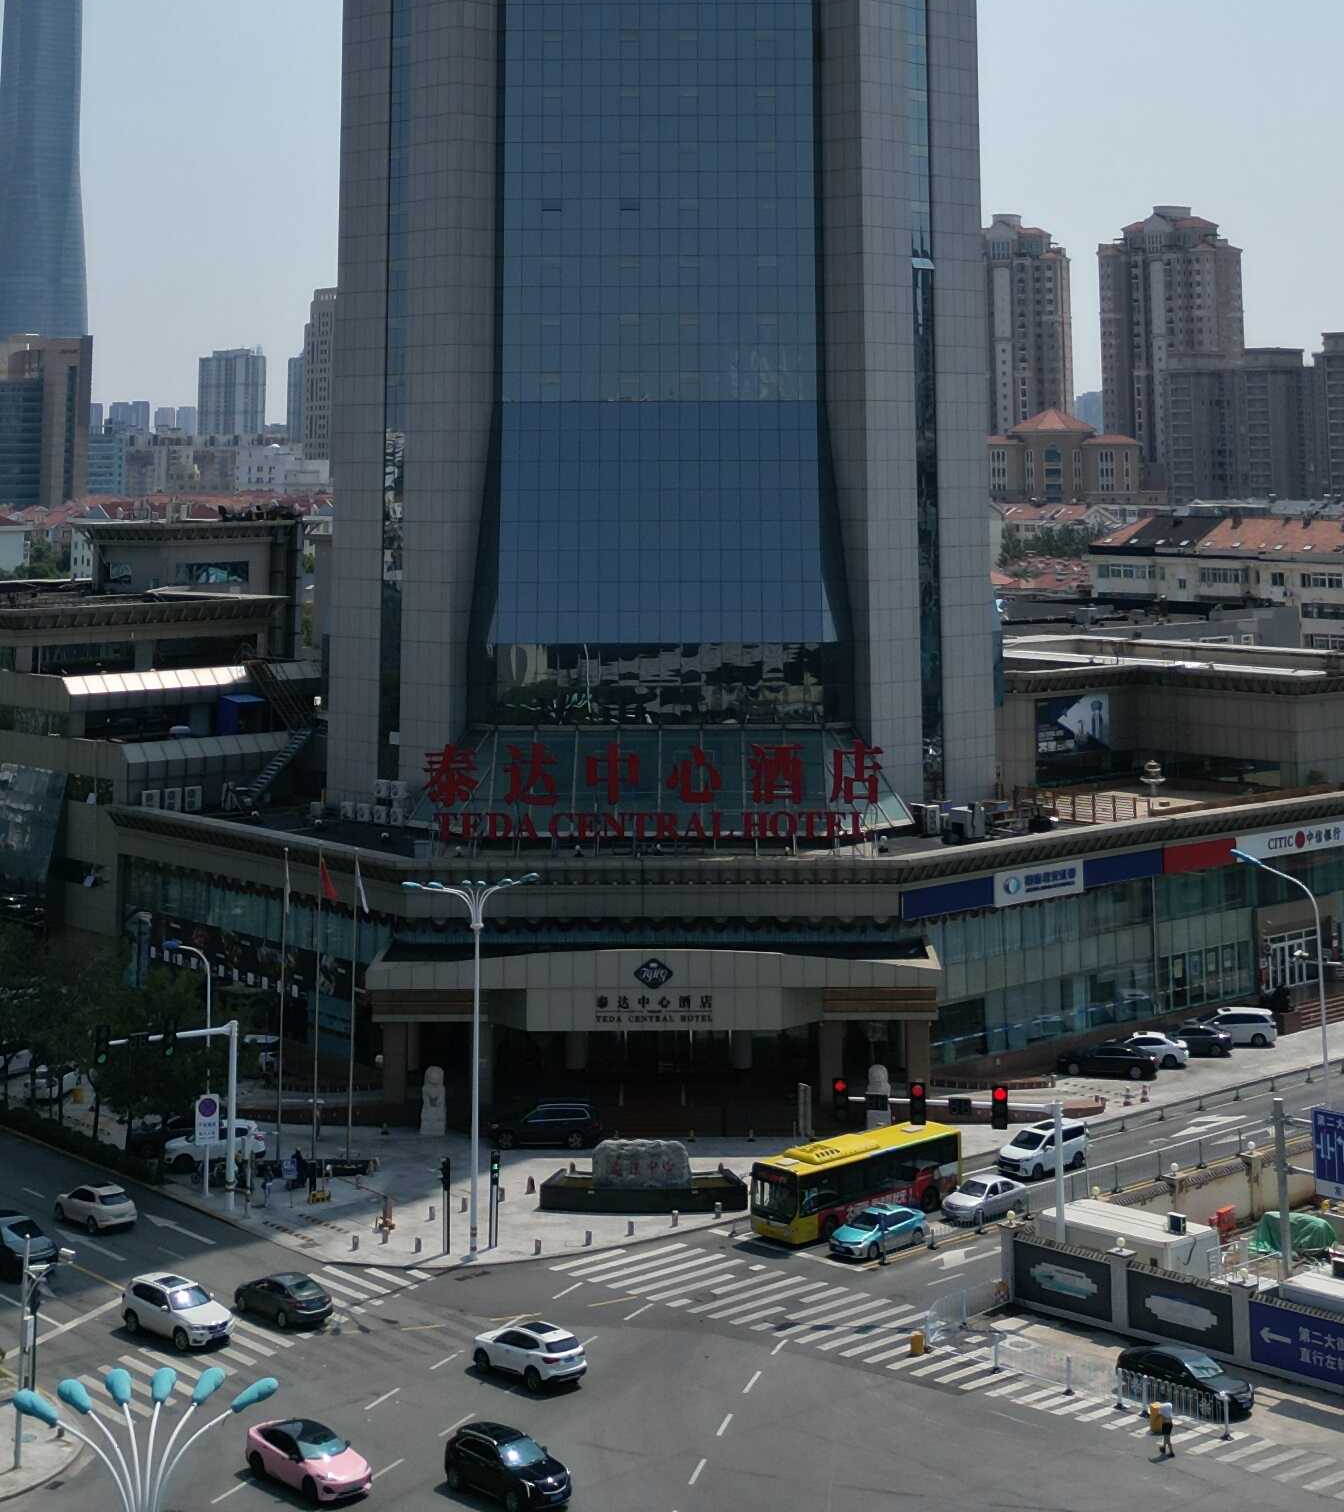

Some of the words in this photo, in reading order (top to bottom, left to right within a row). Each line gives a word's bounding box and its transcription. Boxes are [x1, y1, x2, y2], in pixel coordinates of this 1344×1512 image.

[424, 740, 884, 807] 泰达中心酒店
[433, 812, 540, 840] TEDA
[549, 812, 732, 840] CENTRAL
[740, 812, 870, 840] HOTEL
[1268, 836, 1294, 849] CITIC
[1307, 827, 1342, 845] 中信银行
[596, 995, 713, 1009] 泰达中心酒店
[596, 1015, 623, 1023] TEDA
[628, 1015, 675, 1023] CENTRAL
[680, 1015, 713, 1023] HOTEL
